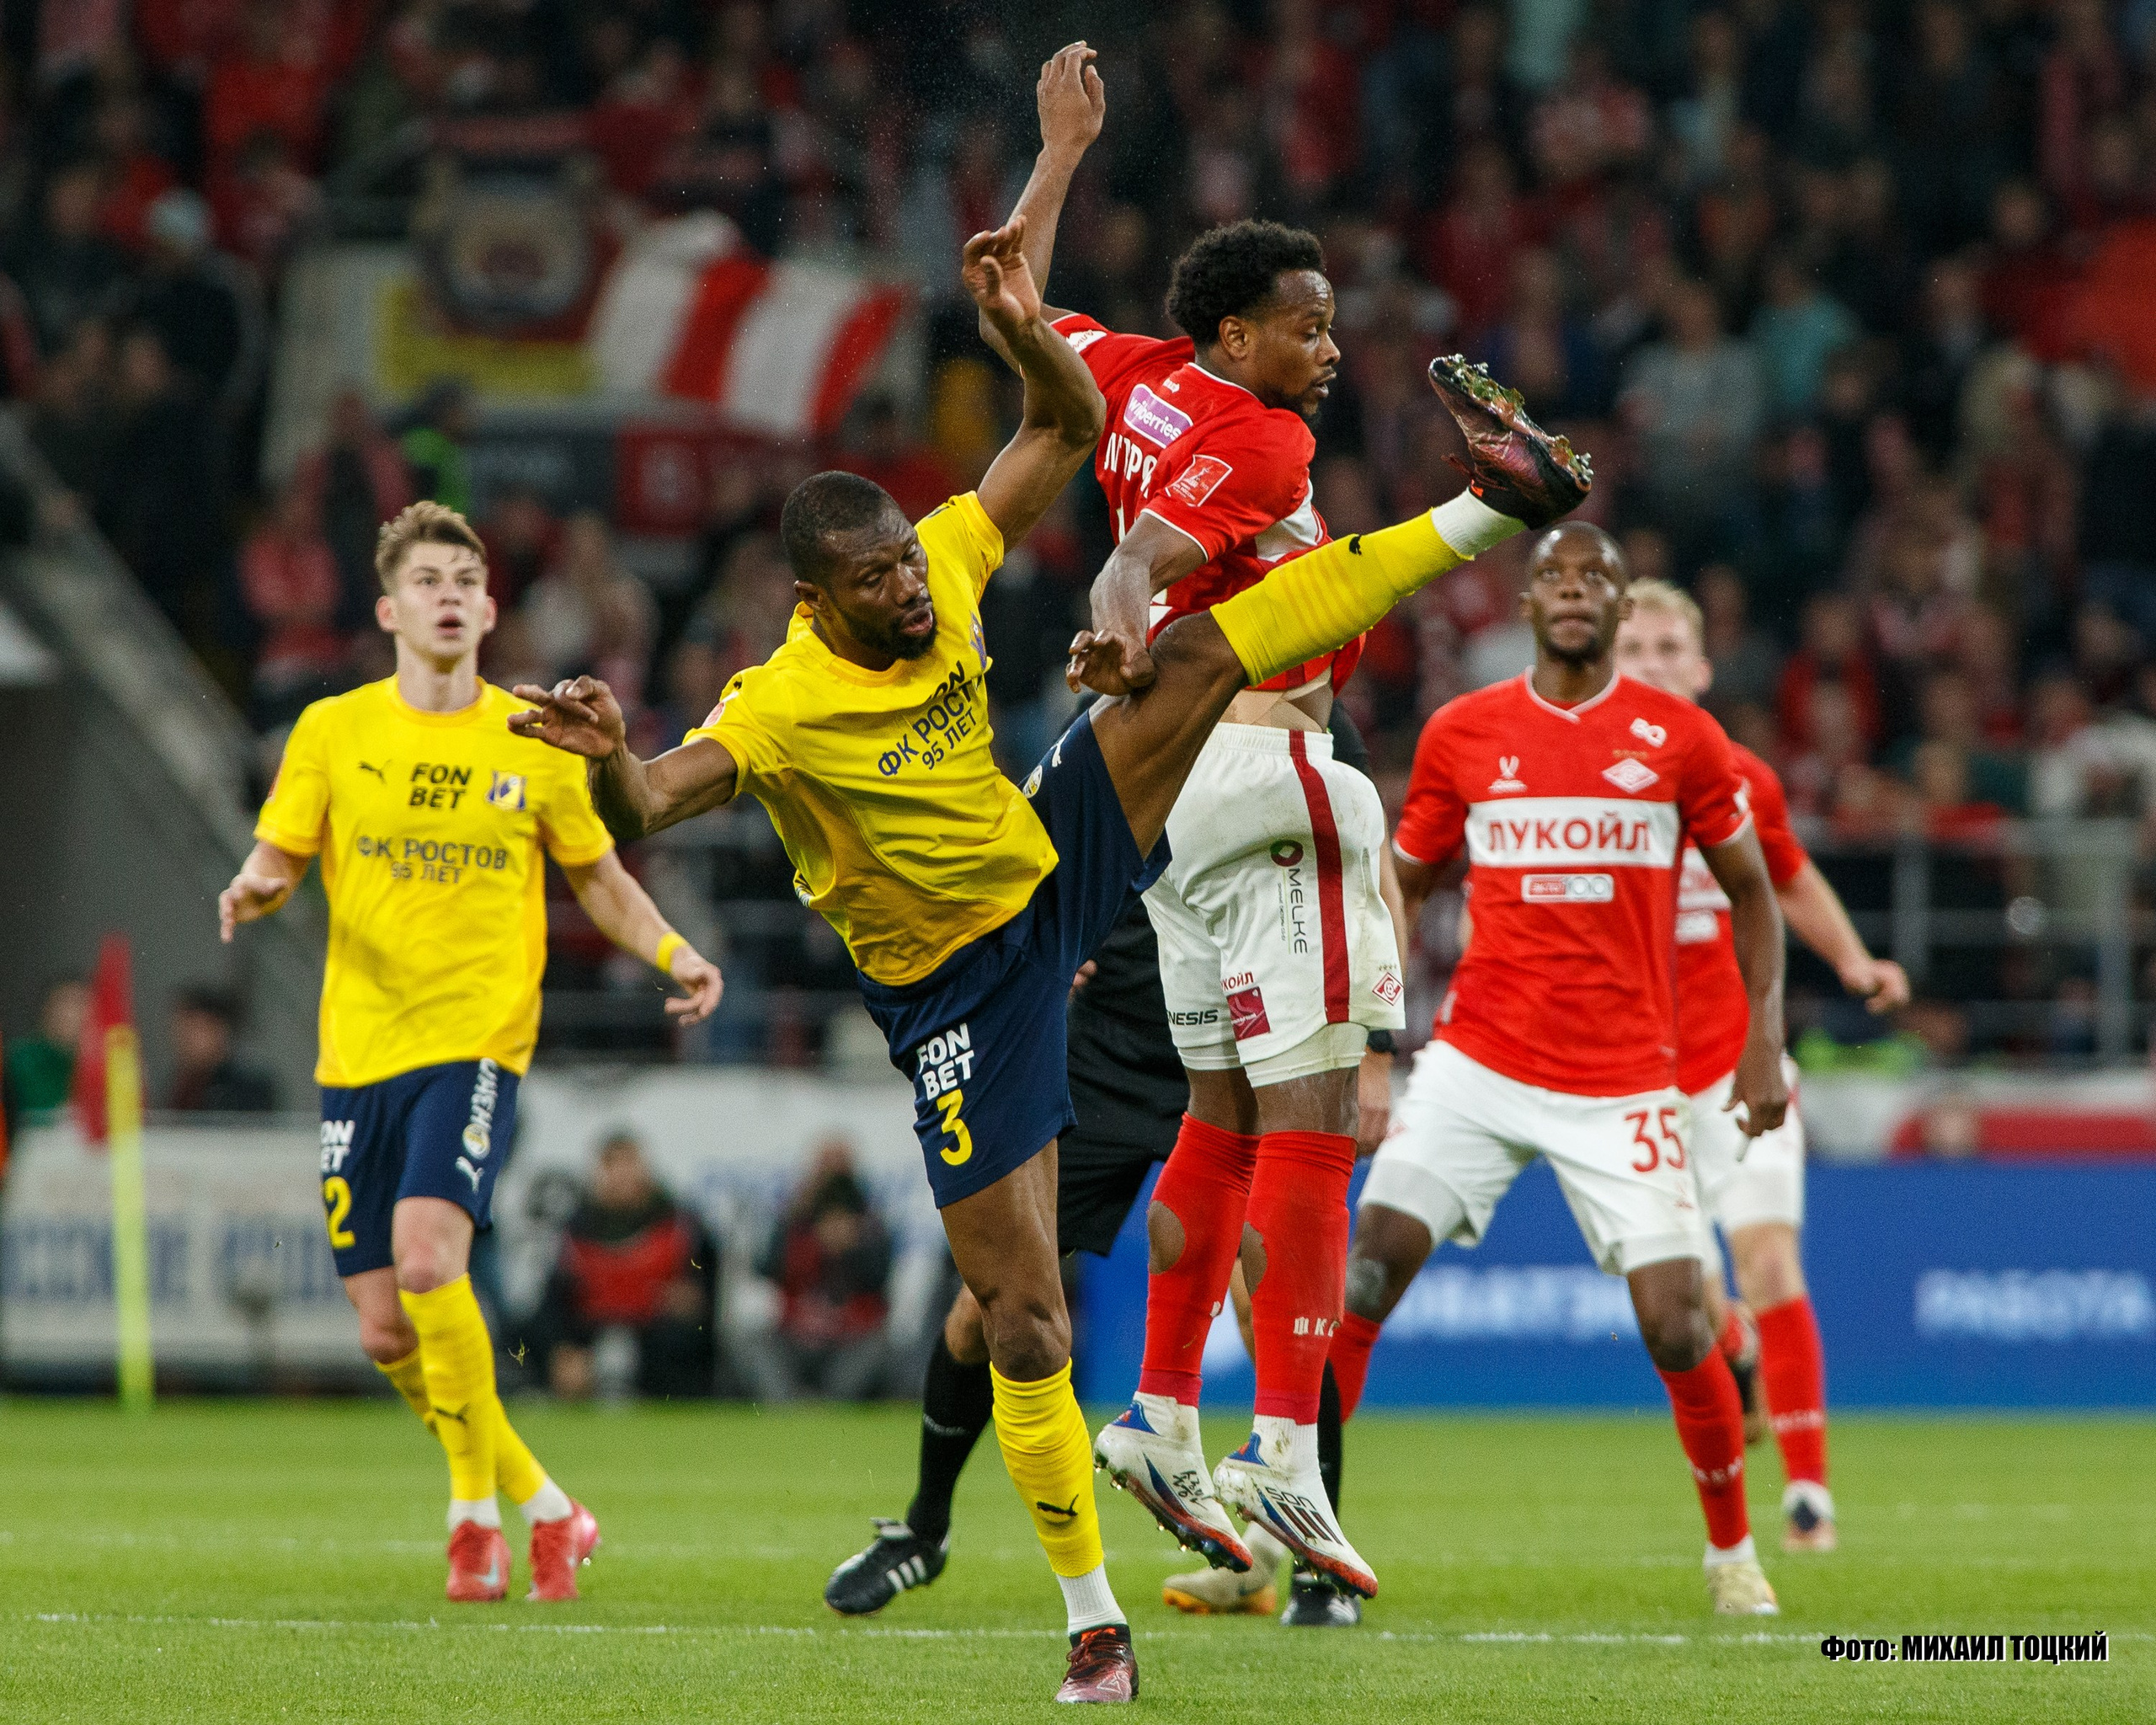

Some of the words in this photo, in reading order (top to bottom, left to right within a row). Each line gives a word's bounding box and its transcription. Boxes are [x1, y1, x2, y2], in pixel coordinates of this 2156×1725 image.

[878, 734, 920, 777] ФК
[921, 741, 944, 770] 95
[943, 706, 977, 750] ЛЕТ
[410, 761, 472, 786] FON
[408, 785, 467, 809] BET
[1487, 810, 1650, 852] ЛУКОЙЛ
[356, 835, 392, 858] ФК
[403, 838, 509, 871] РОСТОВ
[391, 861, 412, 879] 95
[420, 862, 462, 884] ЛЕТ
[1288, 868, 1308, 954] MELKE
[922, 1049, 975, 1102] BET
[936, 1088, 974, 1167] 3
[1623, 1108, 1686, 1172] 35
